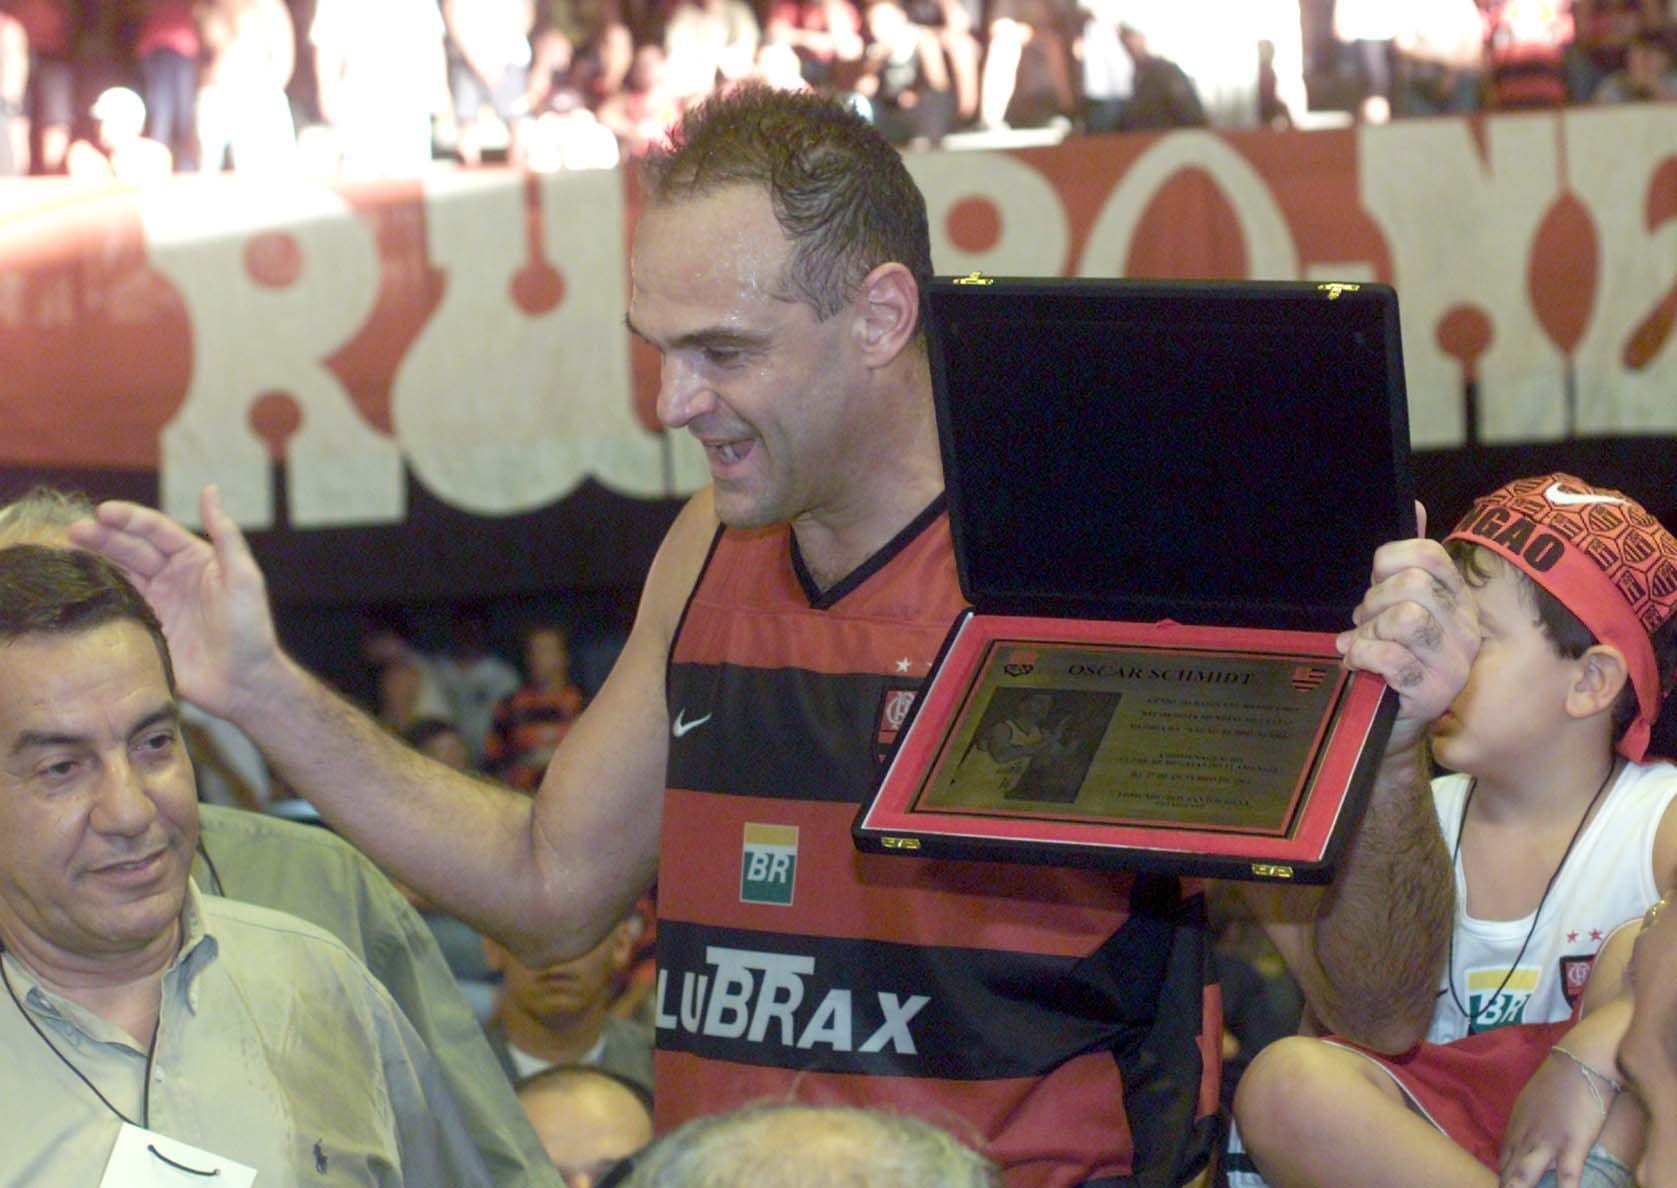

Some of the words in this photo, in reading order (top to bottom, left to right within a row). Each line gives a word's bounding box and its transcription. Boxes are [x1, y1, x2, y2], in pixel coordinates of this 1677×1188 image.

[1067, 664, 1143, 680] OSCAR
[1147, 668, 1254, 686] SCHMIDT
[746, 850, 794, 884] BR
[655, 945, 932, 1056] LUBRAX
[1476, 992, 1530, 1025] BR
